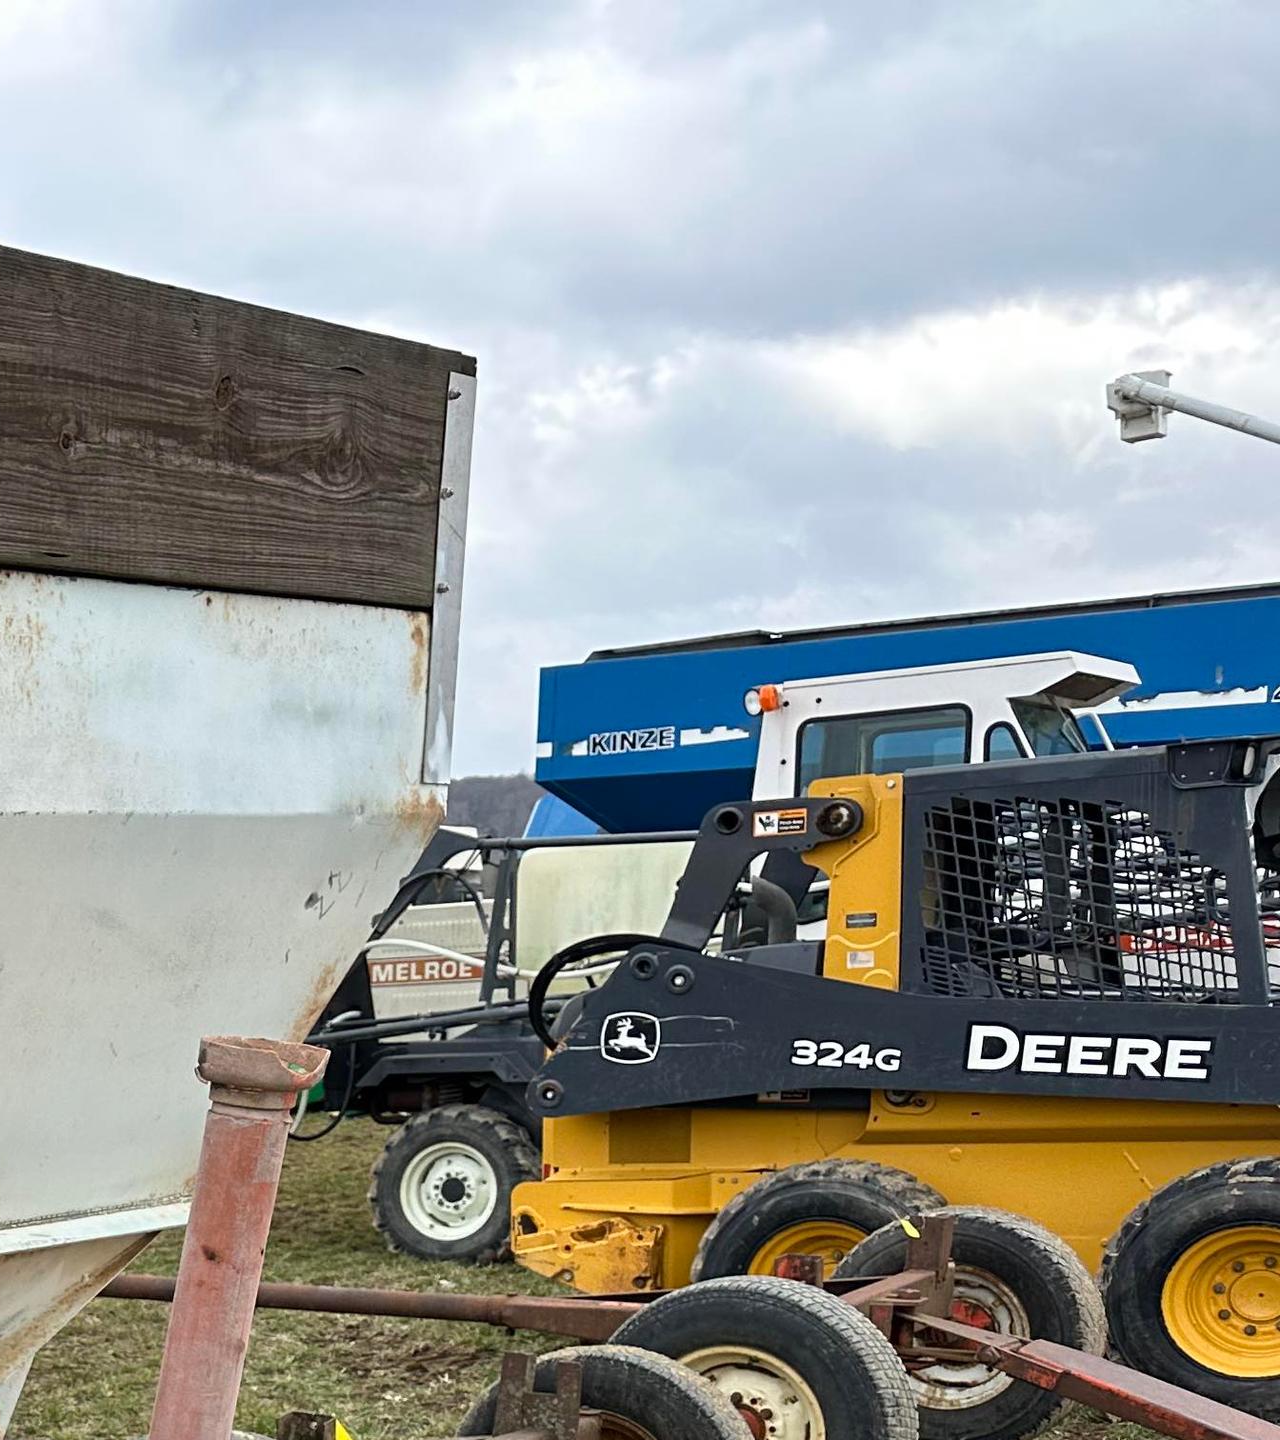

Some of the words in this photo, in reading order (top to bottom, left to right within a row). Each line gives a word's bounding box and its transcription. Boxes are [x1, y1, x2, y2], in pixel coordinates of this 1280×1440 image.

[589, 726, 675, 756] KINZE
[371, 960, 473, 982] MELROE
[791, 1039, 902, 1072] 324G
[966, 1024, 1212, 1080] DEERE
